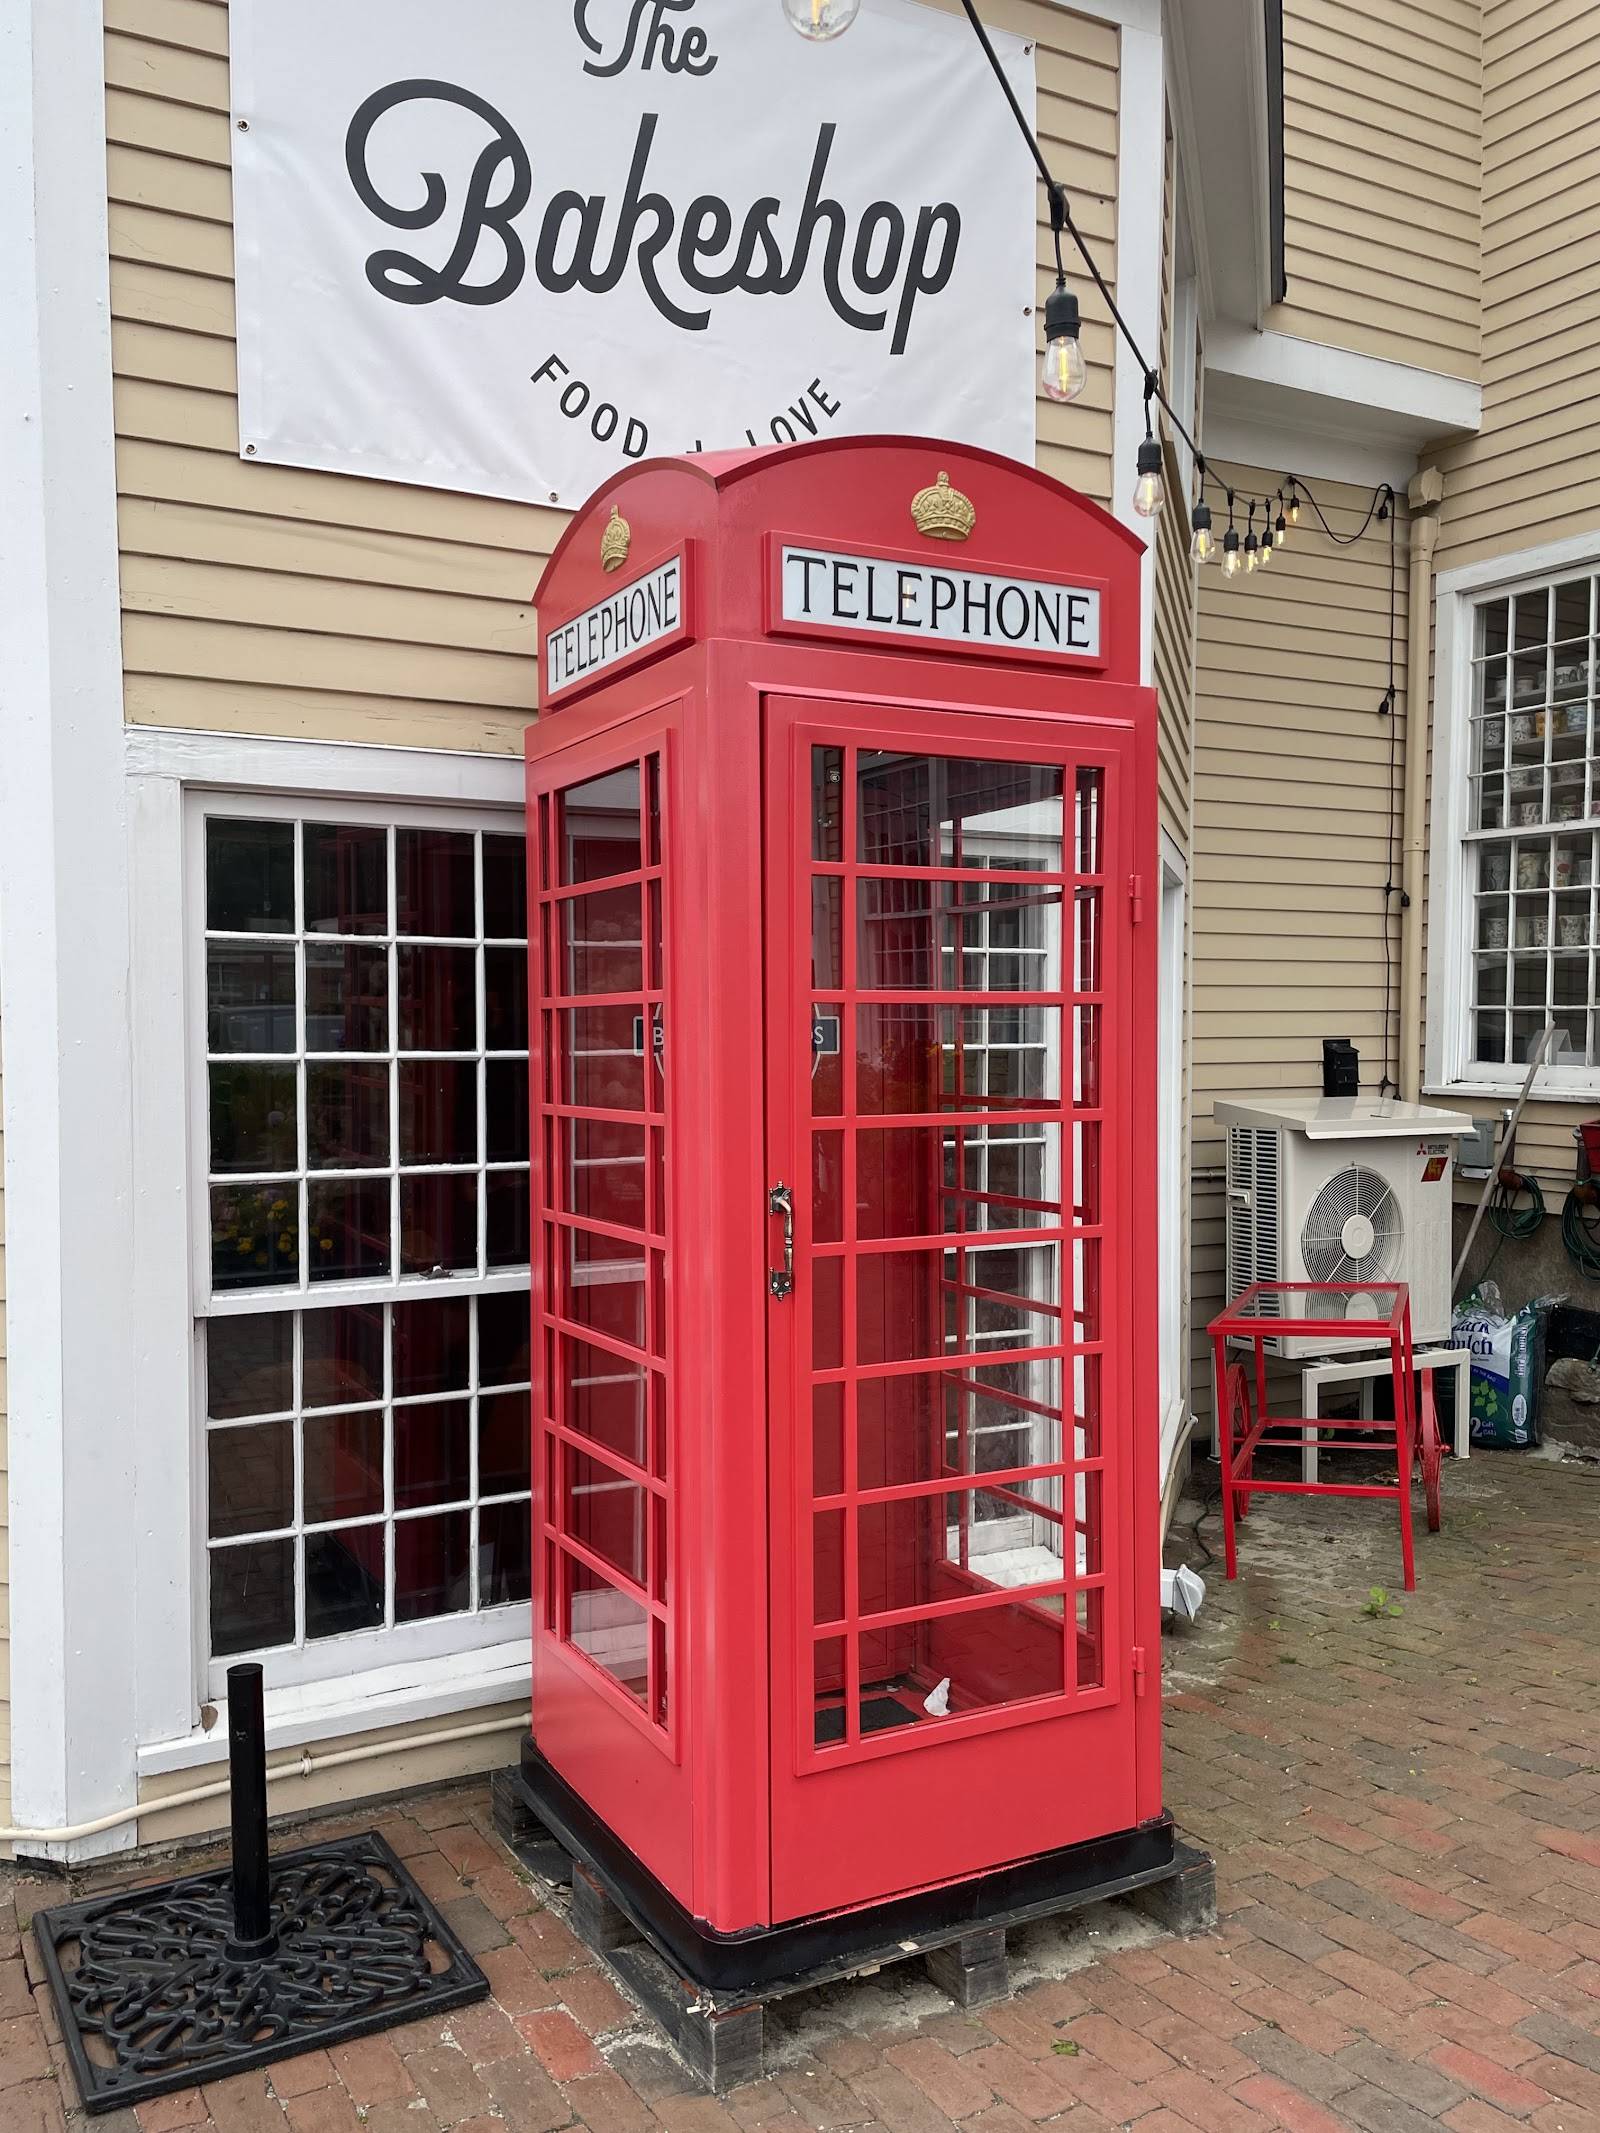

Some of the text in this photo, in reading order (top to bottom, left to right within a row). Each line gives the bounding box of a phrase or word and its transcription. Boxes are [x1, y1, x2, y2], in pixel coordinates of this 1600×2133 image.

[573, 0, 718, 77] The
[346, 79, 961, 355] Bakeshop
[531, 354, 648, 458] FOOD
[549, 567, 677, 683] TELEPHONE
[787, 554, 1090, 648] TELEPHONE
